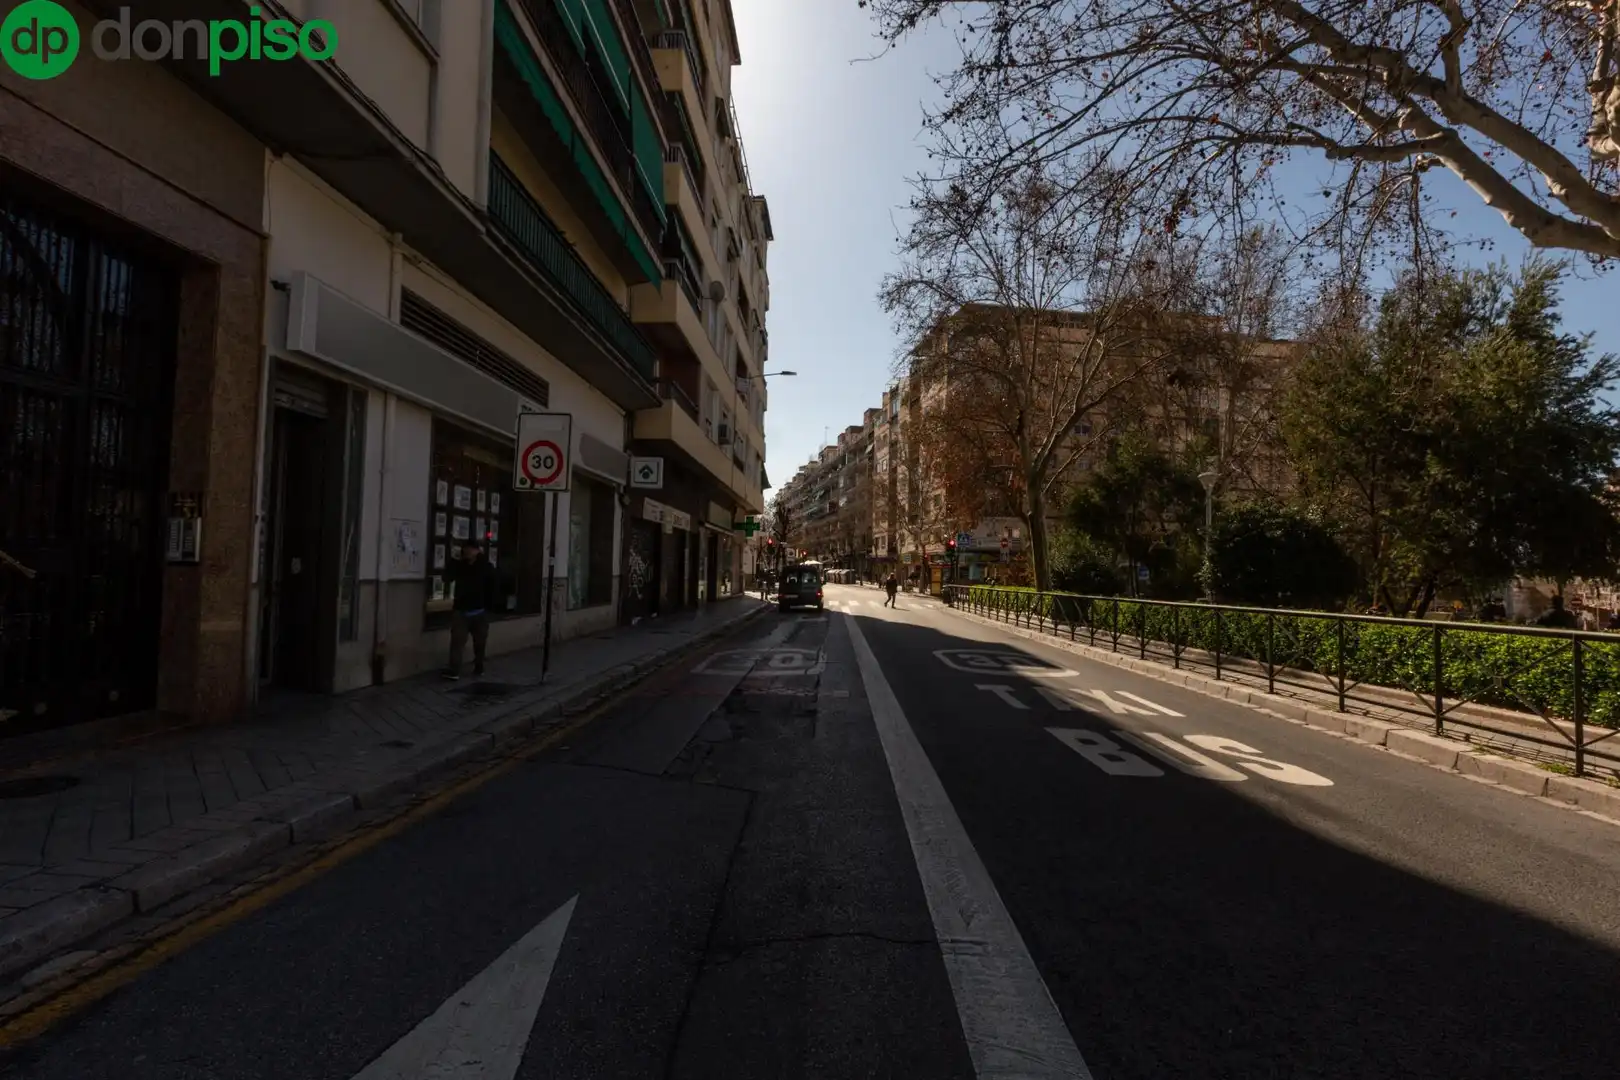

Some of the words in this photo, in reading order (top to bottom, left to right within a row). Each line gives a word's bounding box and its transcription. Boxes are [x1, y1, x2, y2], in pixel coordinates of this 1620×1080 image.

[531, 455, 555, 469] 30
[973, 684, 1187, 717] TAXI
[1043, 727, 1334, 786] BUS
